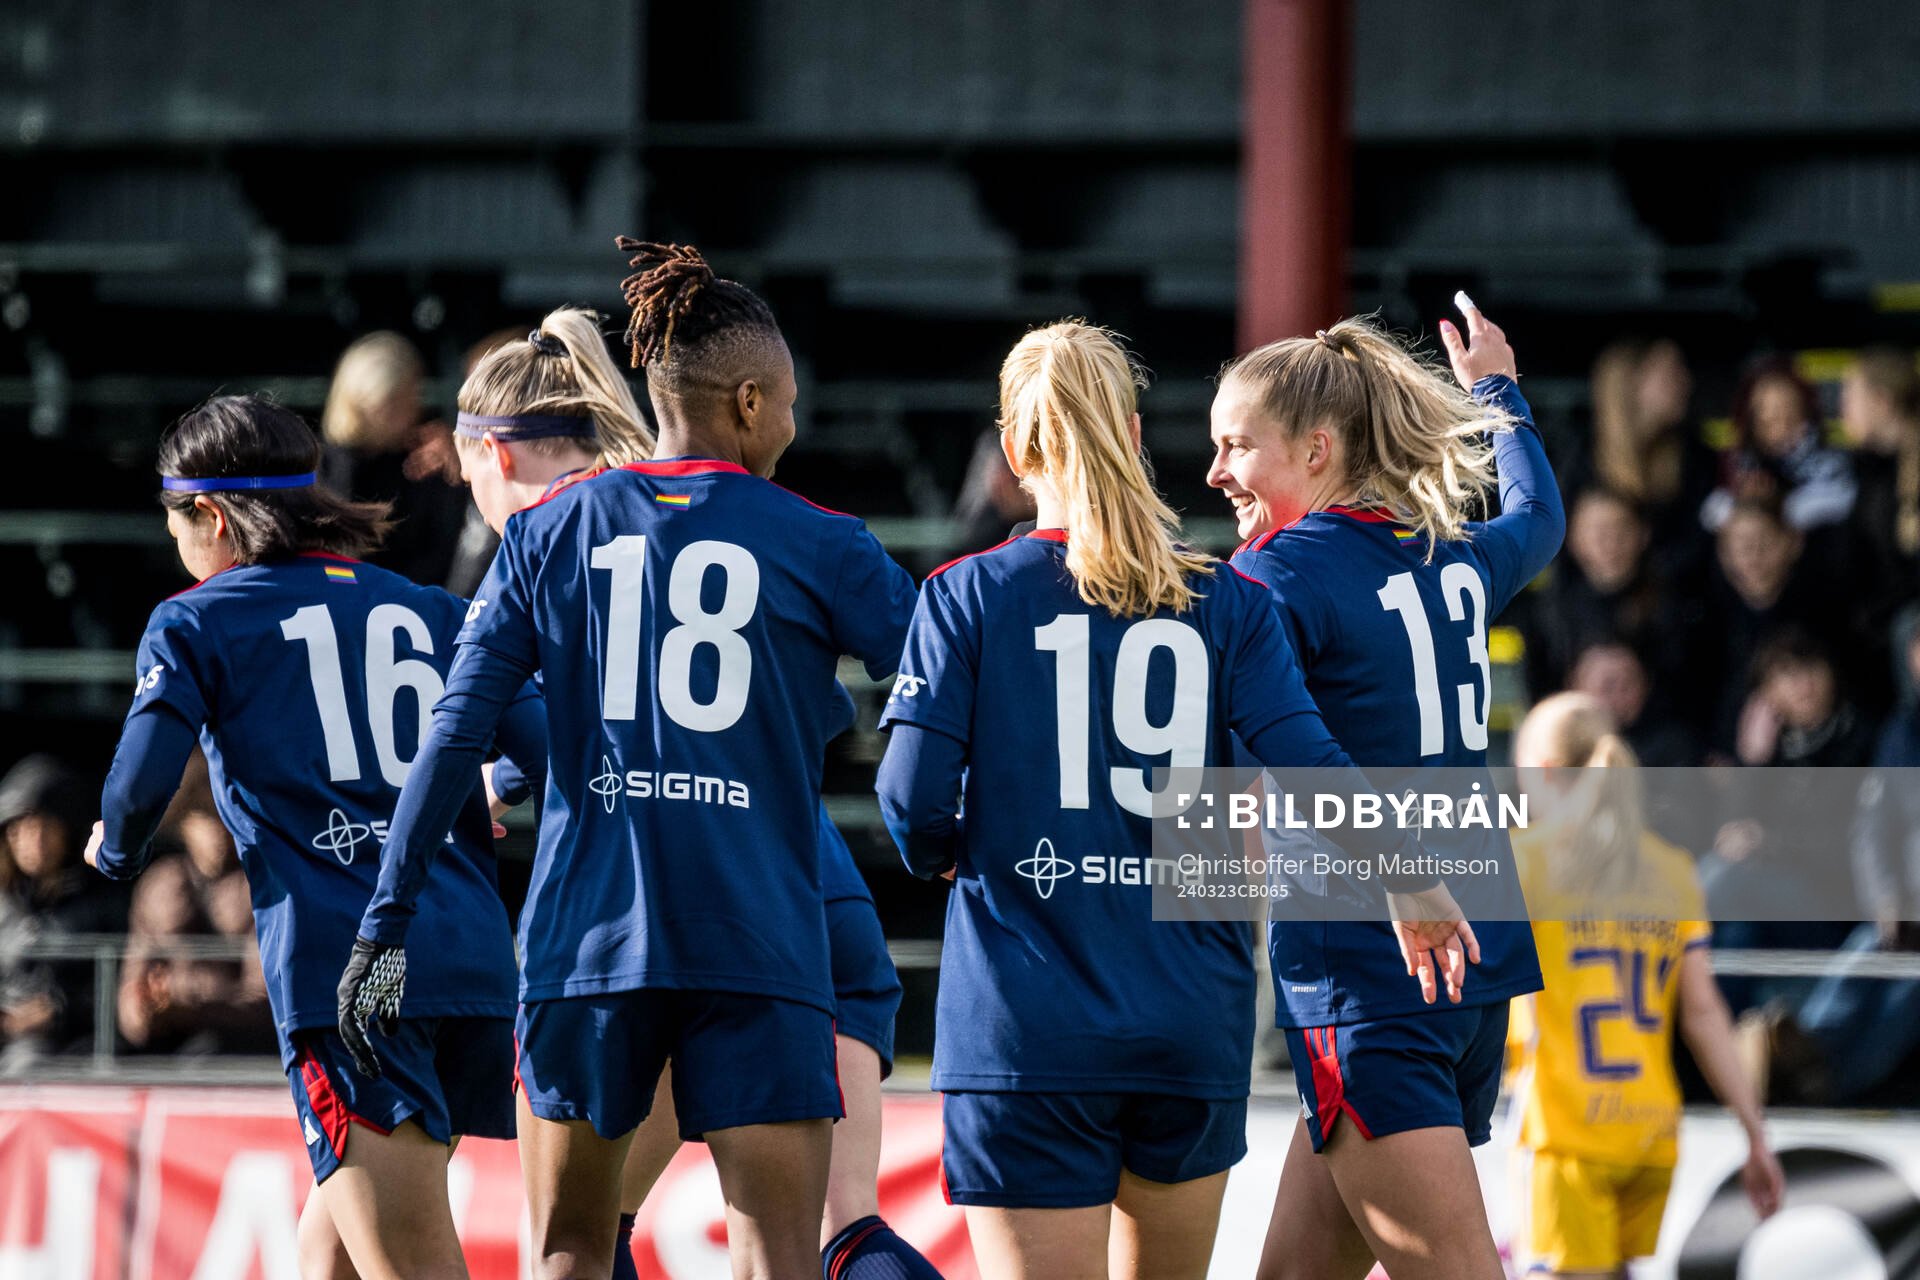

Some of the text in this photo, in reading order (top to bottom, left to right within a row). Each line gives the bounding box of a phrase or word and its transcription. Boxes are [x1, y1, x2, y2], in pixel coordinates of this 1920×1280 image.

[279, 603, 446, 788] 16
[590, 534, 760, 732] 18
[1034, 613, 1209, 818] 19
[1377, 562, 1491, 757] 13
